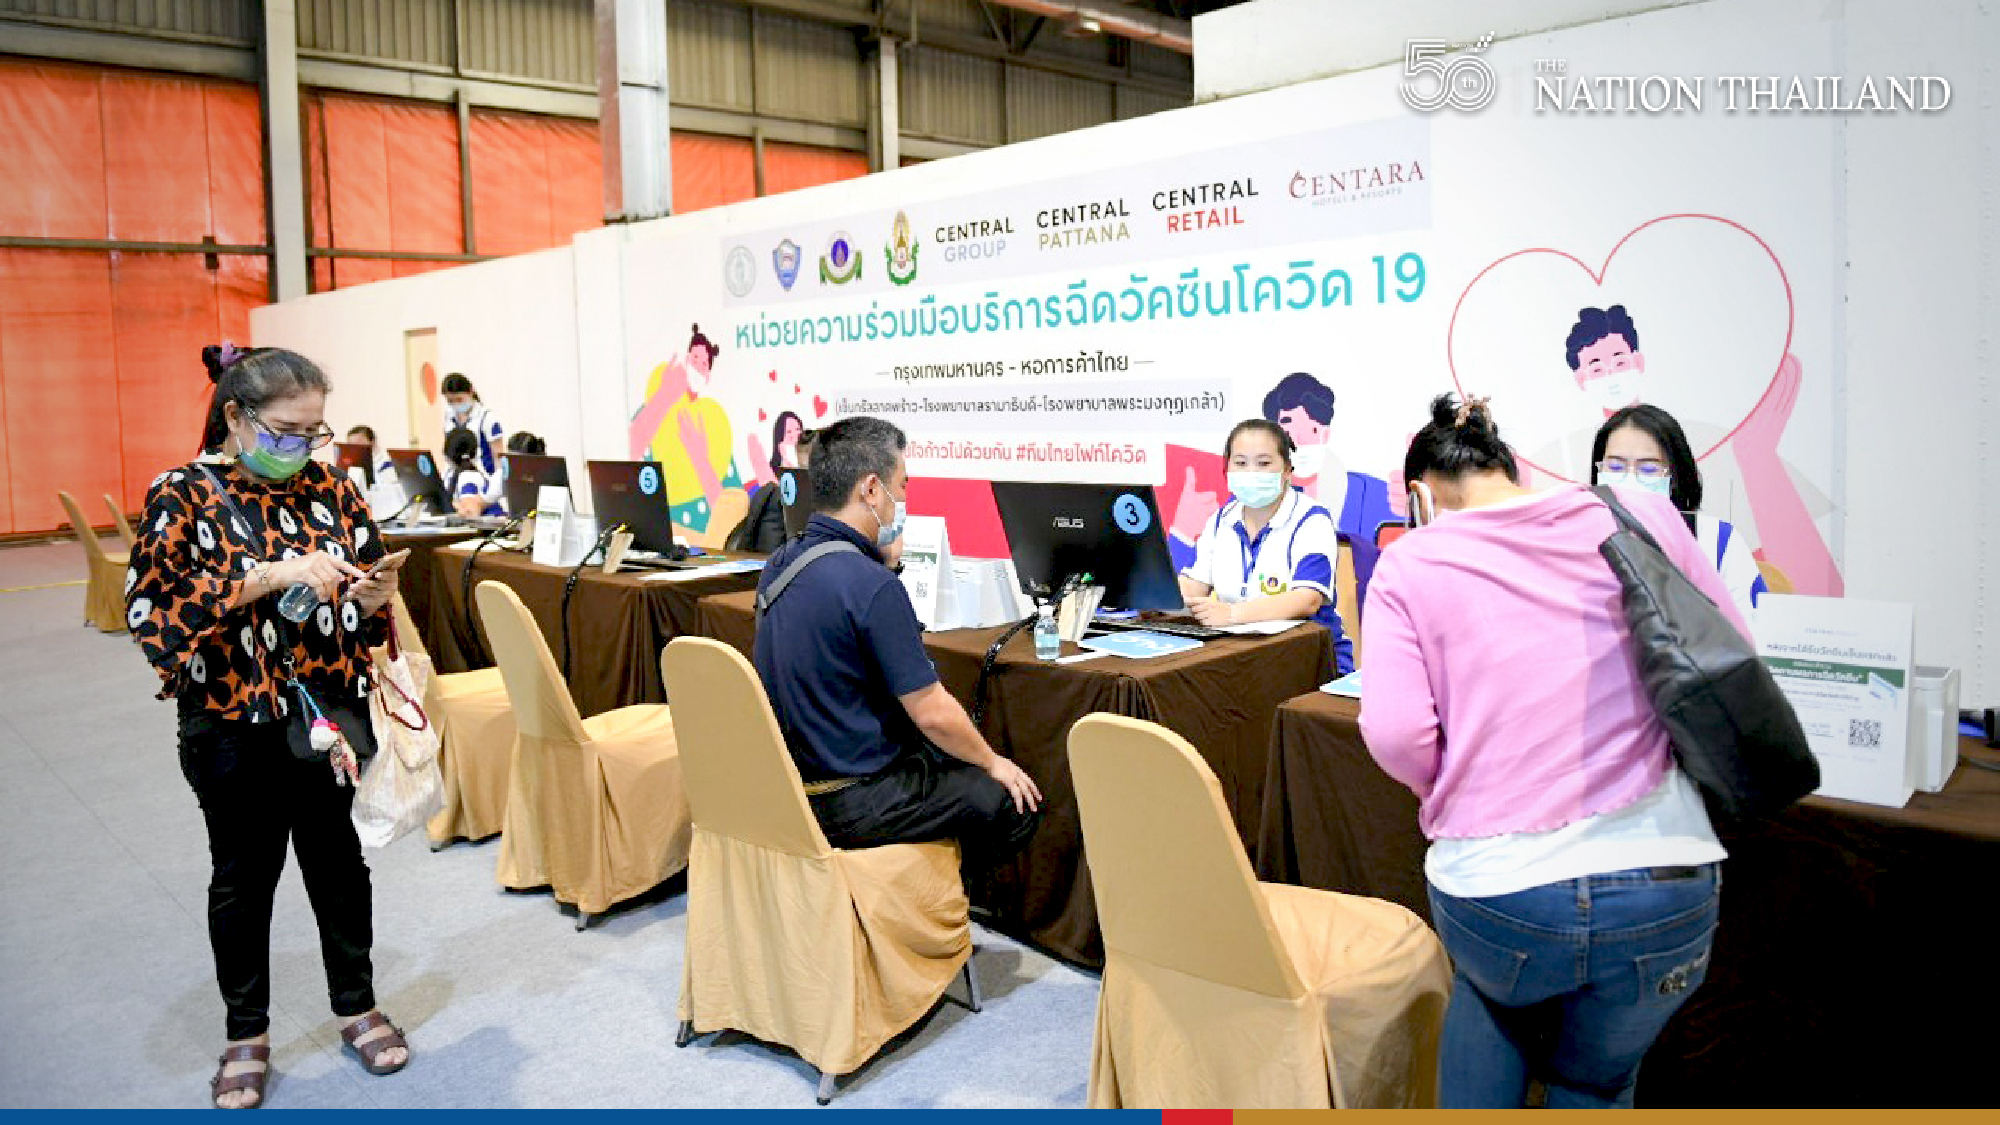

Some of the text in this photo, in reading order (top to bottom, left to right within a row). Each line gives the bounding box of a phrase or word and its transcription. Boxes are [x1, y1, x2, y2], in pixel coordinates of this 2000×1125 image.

[1289, 160, 1426, 199] CENTARA
[1152, 177, 1259, 212] CENTRAL
[1036, 197, 1131, 229] CENTRAL
[1166, 205, 1245, 234] RETAIL
[935, 216, 1014, 243] CENTRAL
[1038, 221, 1131, 251] PATTANA
[944, 239, 1007, 263] GROUP
[735, 251, 1426, 349] หน่วยความร่วมมือบริการฉีดวัคซีนโควิด 19
[893, 360, 1004, 386] กรุงเทพมหานคร
[1021, 350, 1129, 376] หอการค้าไทย
[643, 471, 654, 489] 5
[782, 477, 791, 498] 4
[1052, 516, 1084, 529] ASUS
[1124, 502, 1140, 526] 3
